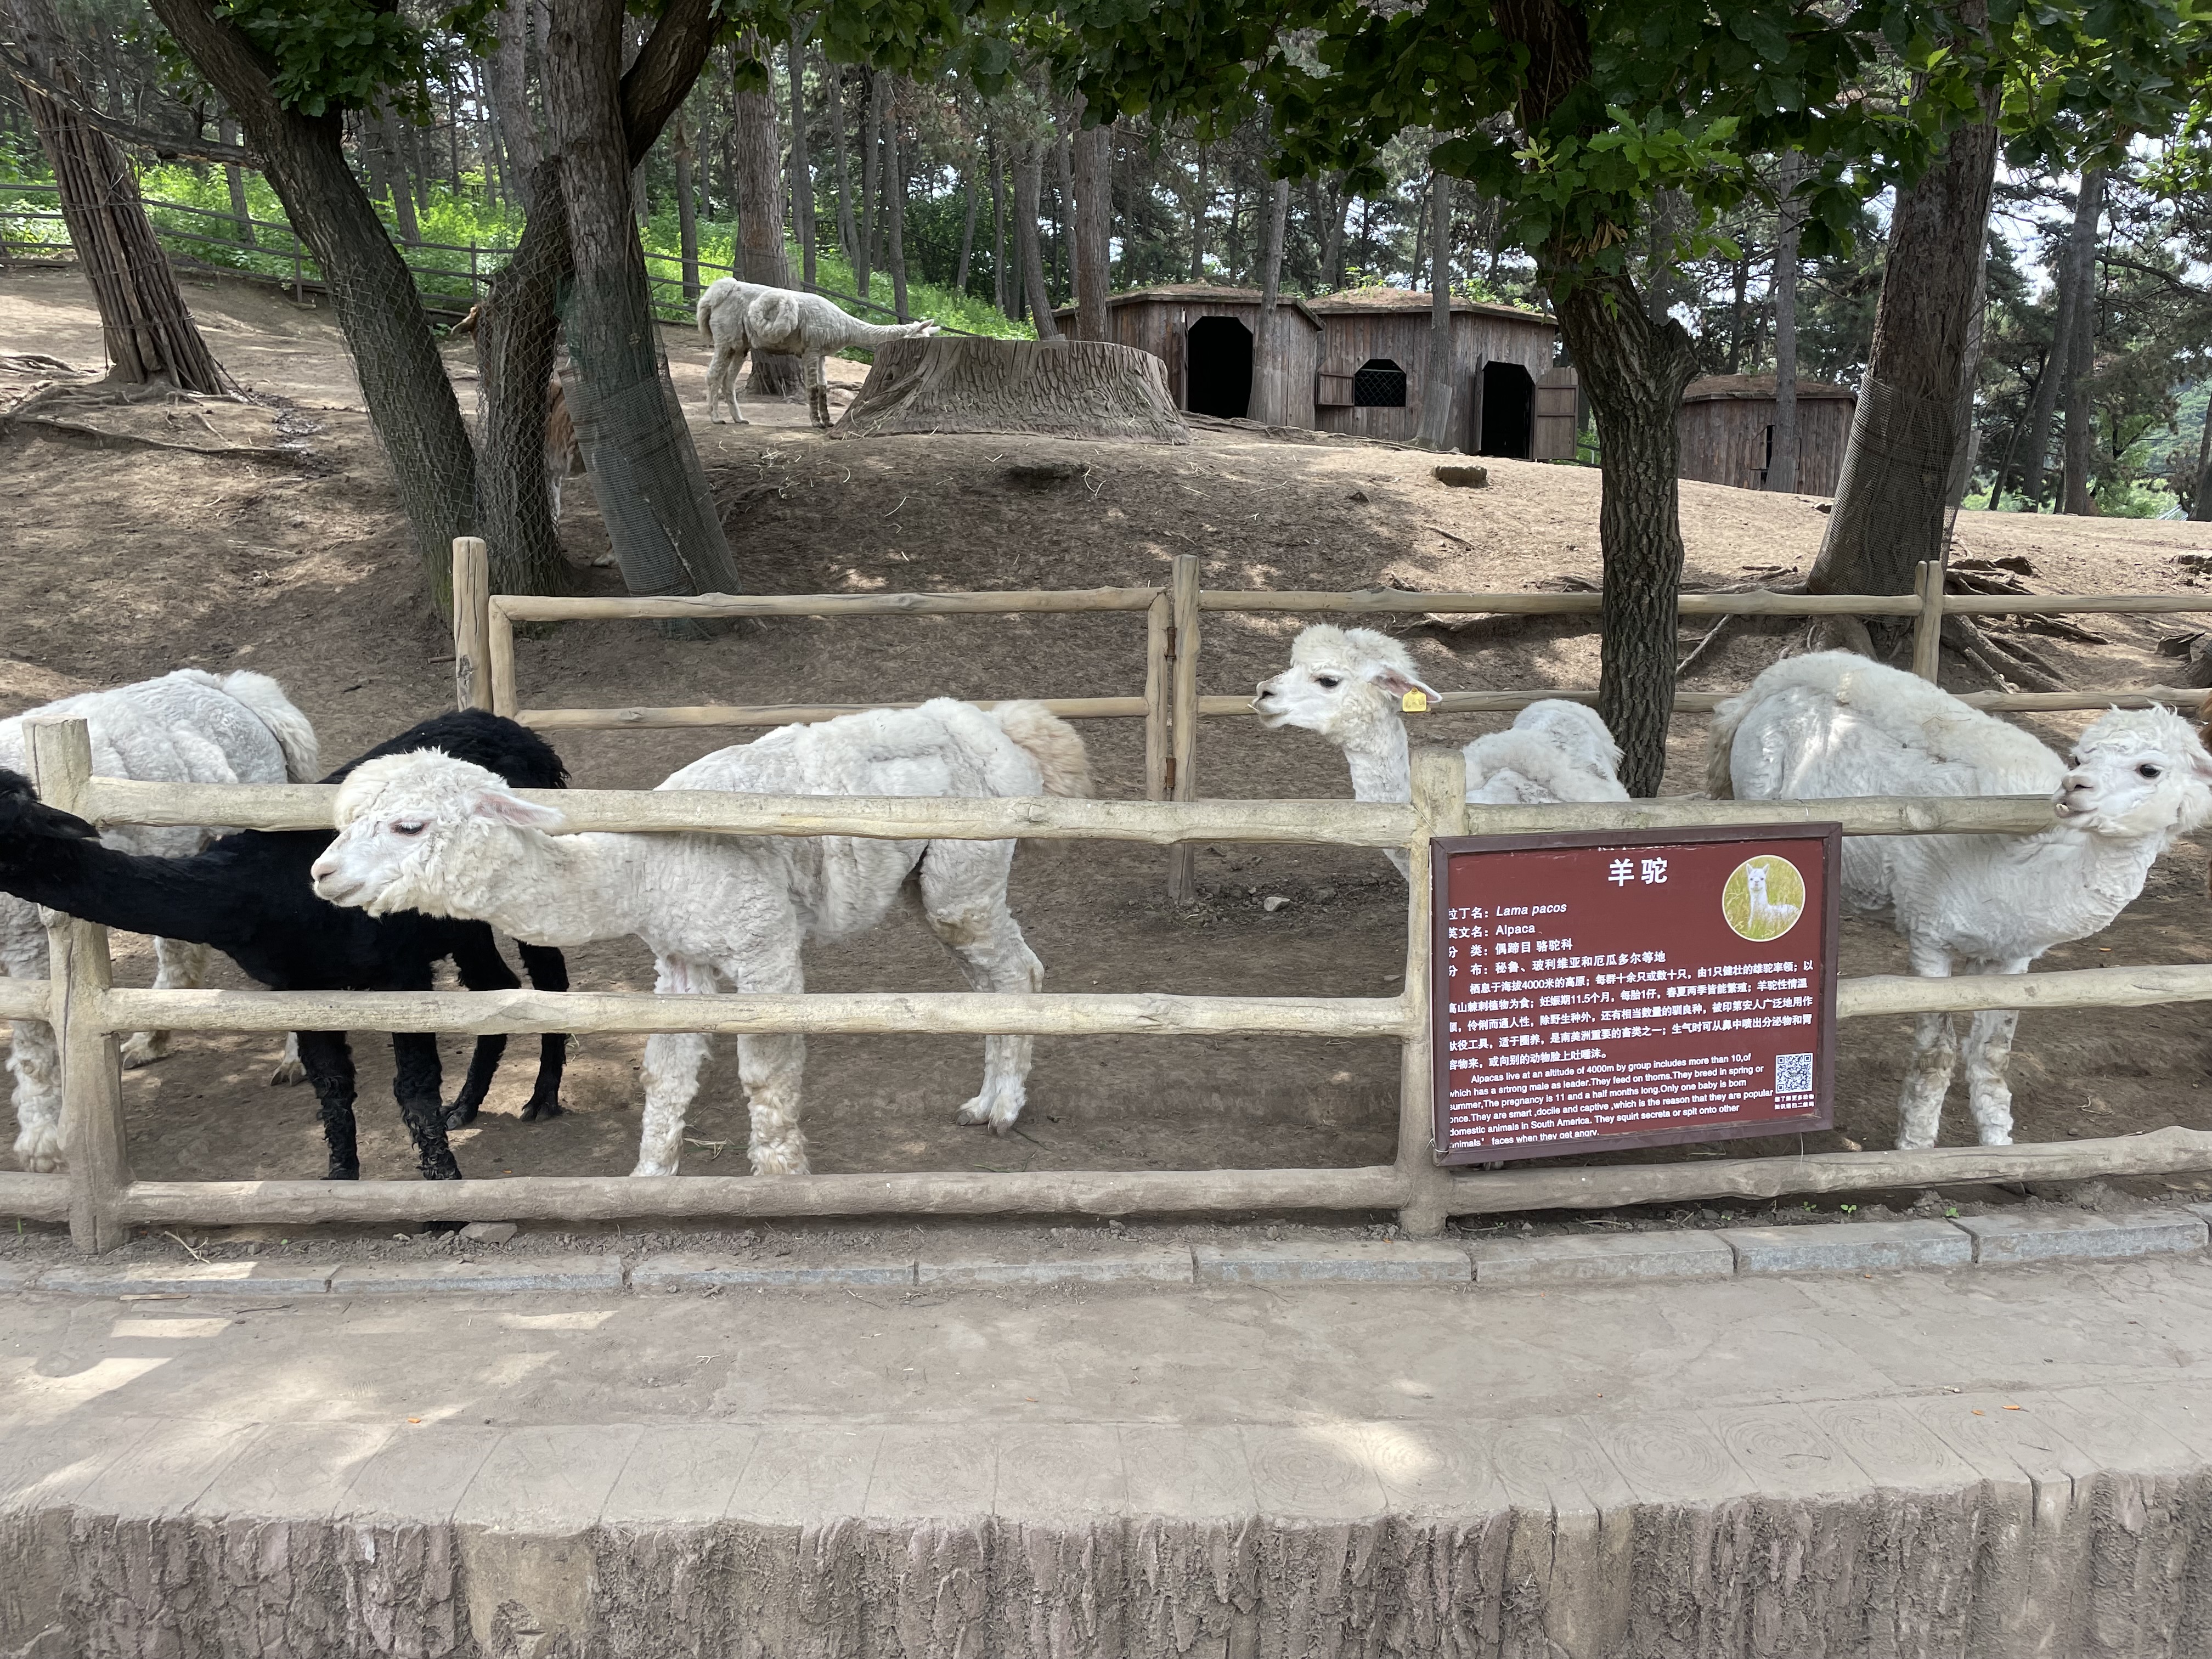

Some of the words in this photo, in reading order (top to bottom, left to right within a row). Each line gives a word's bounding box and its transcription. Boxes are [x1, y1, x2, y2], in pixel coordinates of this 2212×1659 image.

[1609, 857, 1667, 886] 羊驼
[1497, 906, 1528, 916] Lama
[1532, 904, 1567, 916] pacos
[1496, 924, 1536, 936] Alpaca
[1450, 1088, 1471, 1097] which
[1530, 1082, 1549, 1091] male
[1613, 1075, 1630, 1084] feed
[1695, 1068, 1717, 1077] breed
[1729, 1066, 1753, 1076] spring
[1471, 1075, 1504, 1084] Alpacas
[1545, 1068, 1575, 1077] altitude
[1577, 1066, 1584, 1074] of
[1587, 1065, 1614, 1073] 4000m
[1617, 1064, 1626, 1073] by
[1628, 1063, 1651, 1072] group
[1654, 1059, 1686, 1068] includes
[1502, 1097, 1544, 1108] pregnancy
[1567, 1092, 1583, 1100] and
[1593, 1090, 1607, 1098] half
[1610, 1087, 1639, 1097] months
[1698, 1081, 1718, 1090] baby
[1509, 1109, 1532, 1118] smart
[1563, 1104, 1578, 1113] and
[1580, 1103, 1609, 1113] captive
[1709, 1093, 1726, 1102] they
[1743, 1089, 1773, 1100] popular
[1450, 1126, 1486, 1136] domestic
[1488, 1123, 1519, 1132] animals
[1531, 1120, 1554, 1128] South
[1594, 1115, 1615, 1124] They
[1617, 1113, 1639, 1122] squirt
[1683, 1107, 1697, 1117] spit
[1719, 1104, 1740, 1113] other
